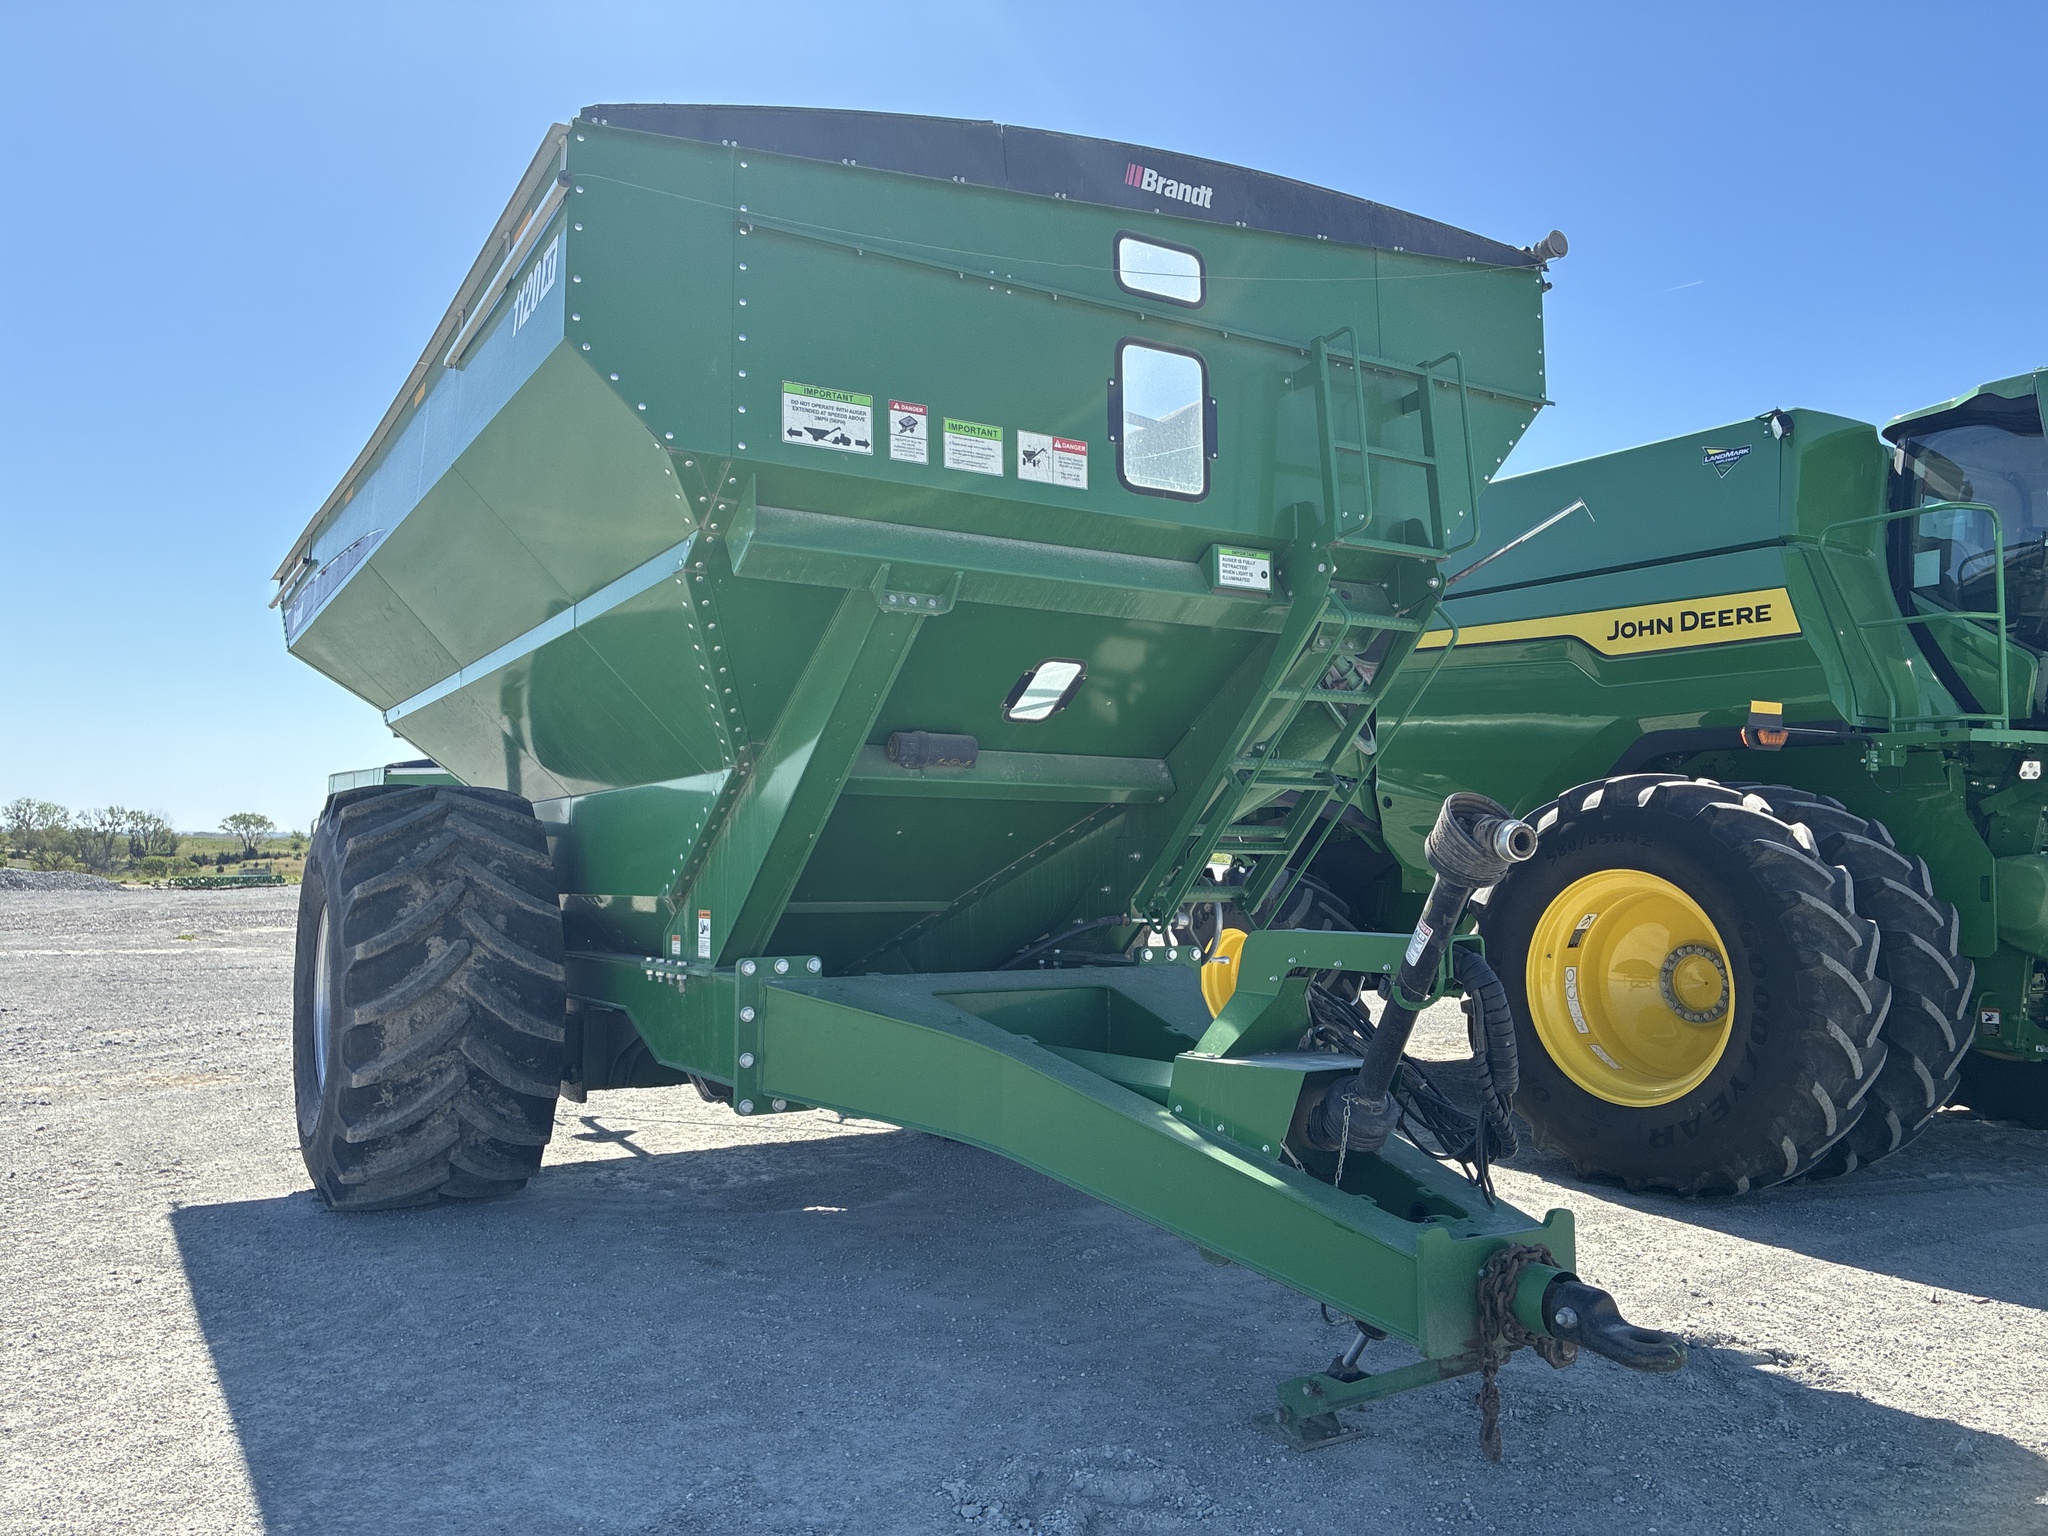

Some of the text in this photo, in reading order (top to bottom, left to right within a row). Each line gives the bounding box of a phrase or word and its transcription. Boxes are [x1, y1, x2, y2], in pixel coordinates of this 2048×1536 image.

[1141, 167, 1213, 209] Brandt
[803, 387, 854, 402] IMPORTANT
[792, 406, 820, 415] EXTENDED
[827, 410, 848, 419] SPEEDS
[848, 414, 866, 422] ABOVE
[812, 402, 834, 411] OPERATE
[849, 408, 867, 416] AUGER
[901, 404, 924, 413] DANGER
[948, 422, 999, 437] IMPORTANT
[1062, 442, 1086, 452] DANGER
[1704, 447, 1750, 463] LANDMARK
[1606, 603, 1772, 641] JOHN DEERE
